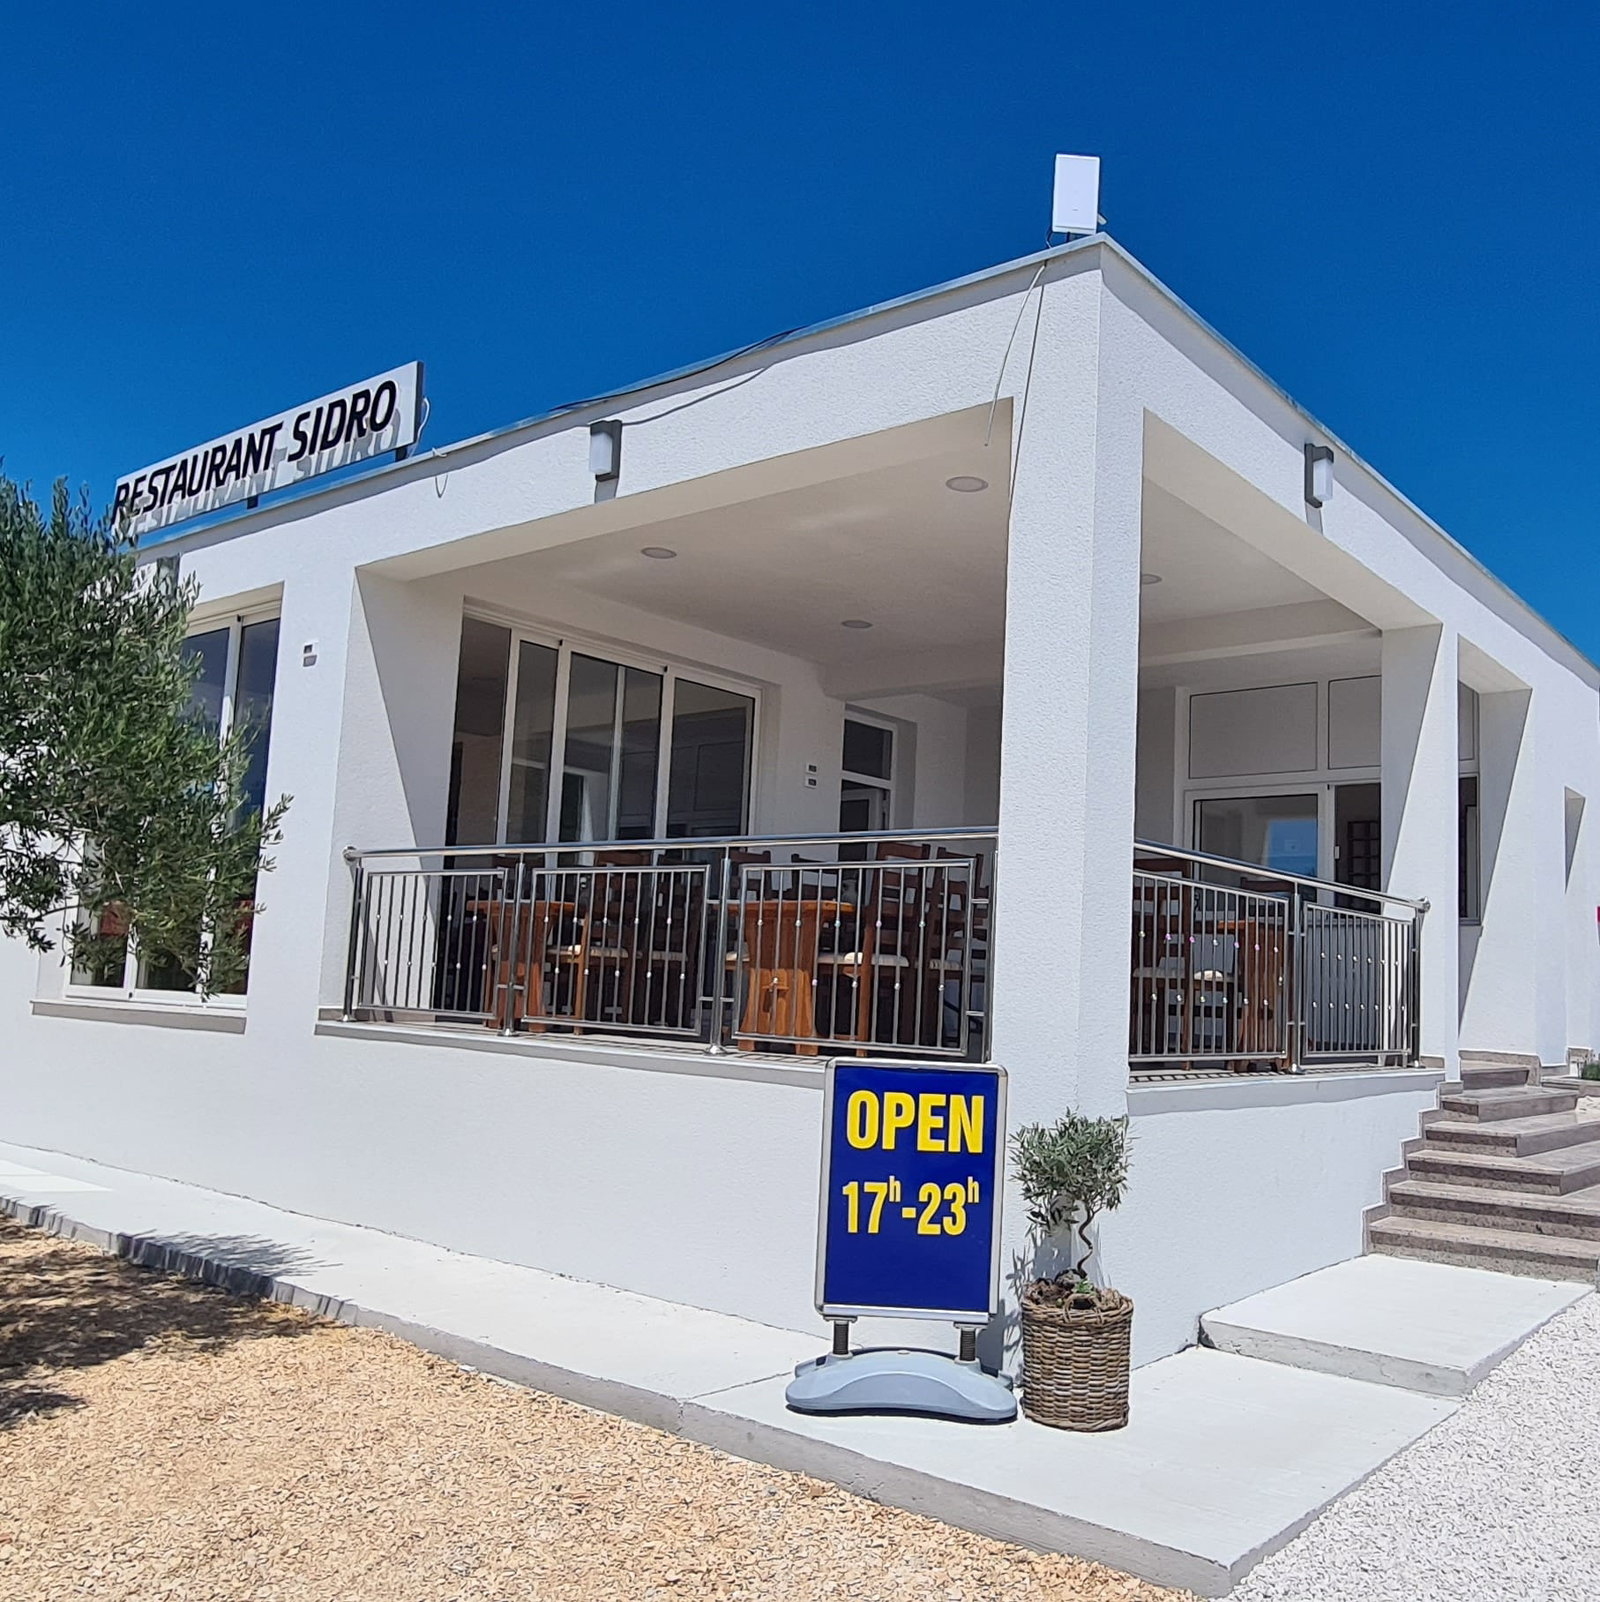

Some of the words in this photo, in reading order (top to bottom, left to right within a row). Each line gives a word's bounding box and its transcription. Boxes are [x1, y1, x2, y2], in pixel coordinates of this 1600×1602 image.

[110, 421, 284, 530] RESTAURANT
[288, 380, 397, 462] SIDRO
[846, 1090, 985, 1153] OPEN
[842, 1175, 980, 1235] 17h-23h
